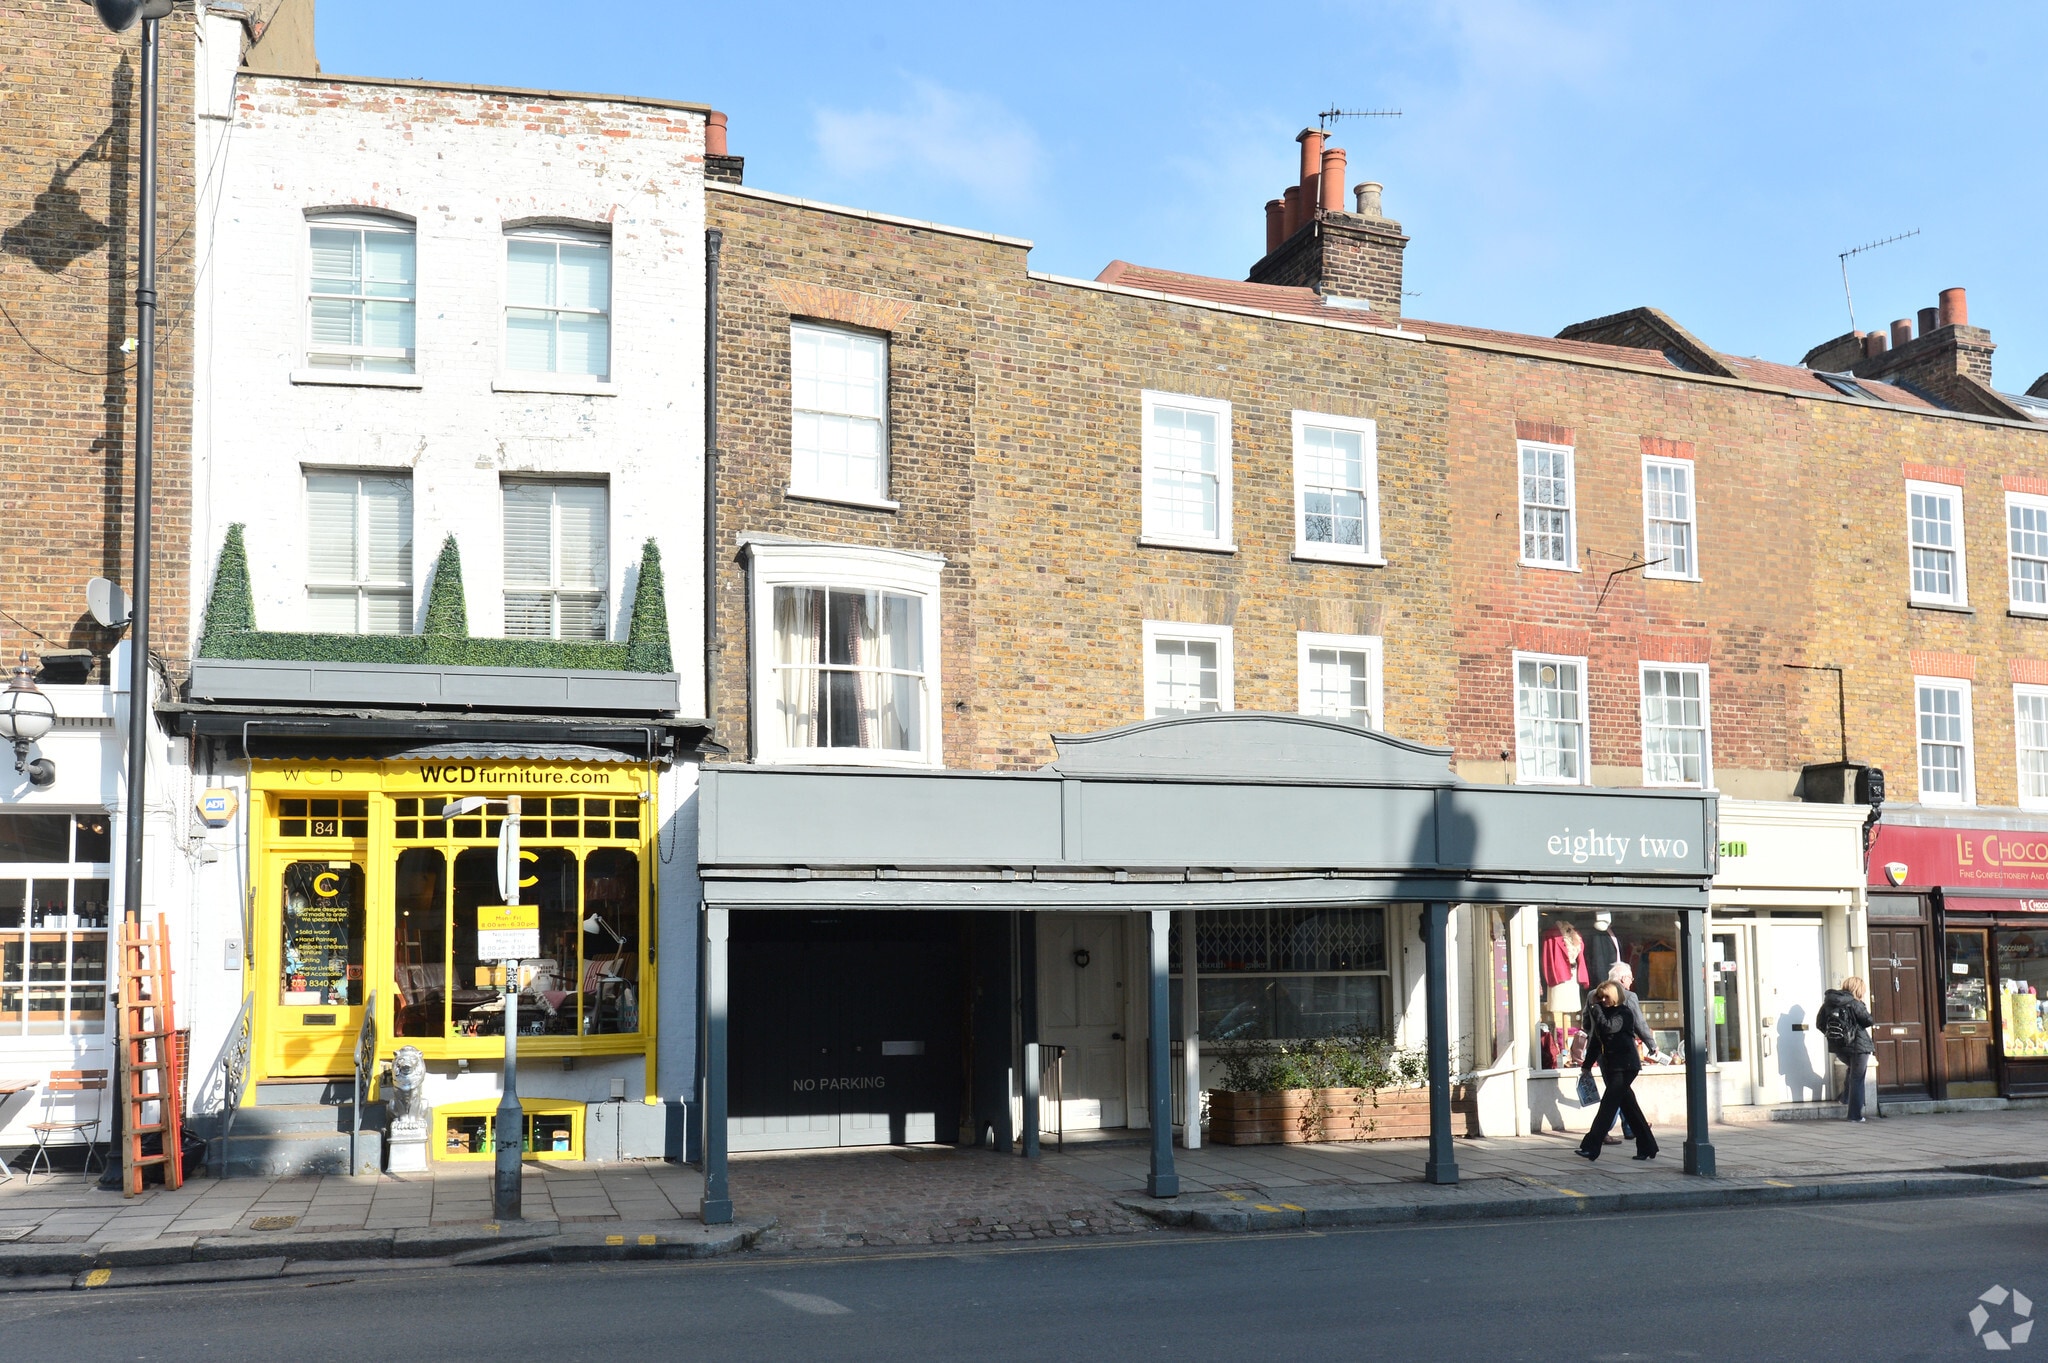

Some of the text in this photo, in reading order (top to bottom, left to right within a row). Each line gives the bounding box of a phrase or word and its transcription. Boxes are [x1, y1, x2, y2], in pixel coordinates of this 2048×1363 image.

[420, 765, 610, 784] WCDfurniture.com
[206, 799, 224, 809] ADT
[315, 821, 334, 835] 84
[1547, 827, 1688, 865] eighty two
[793, 1076, 886, 1091] NO PARKING
